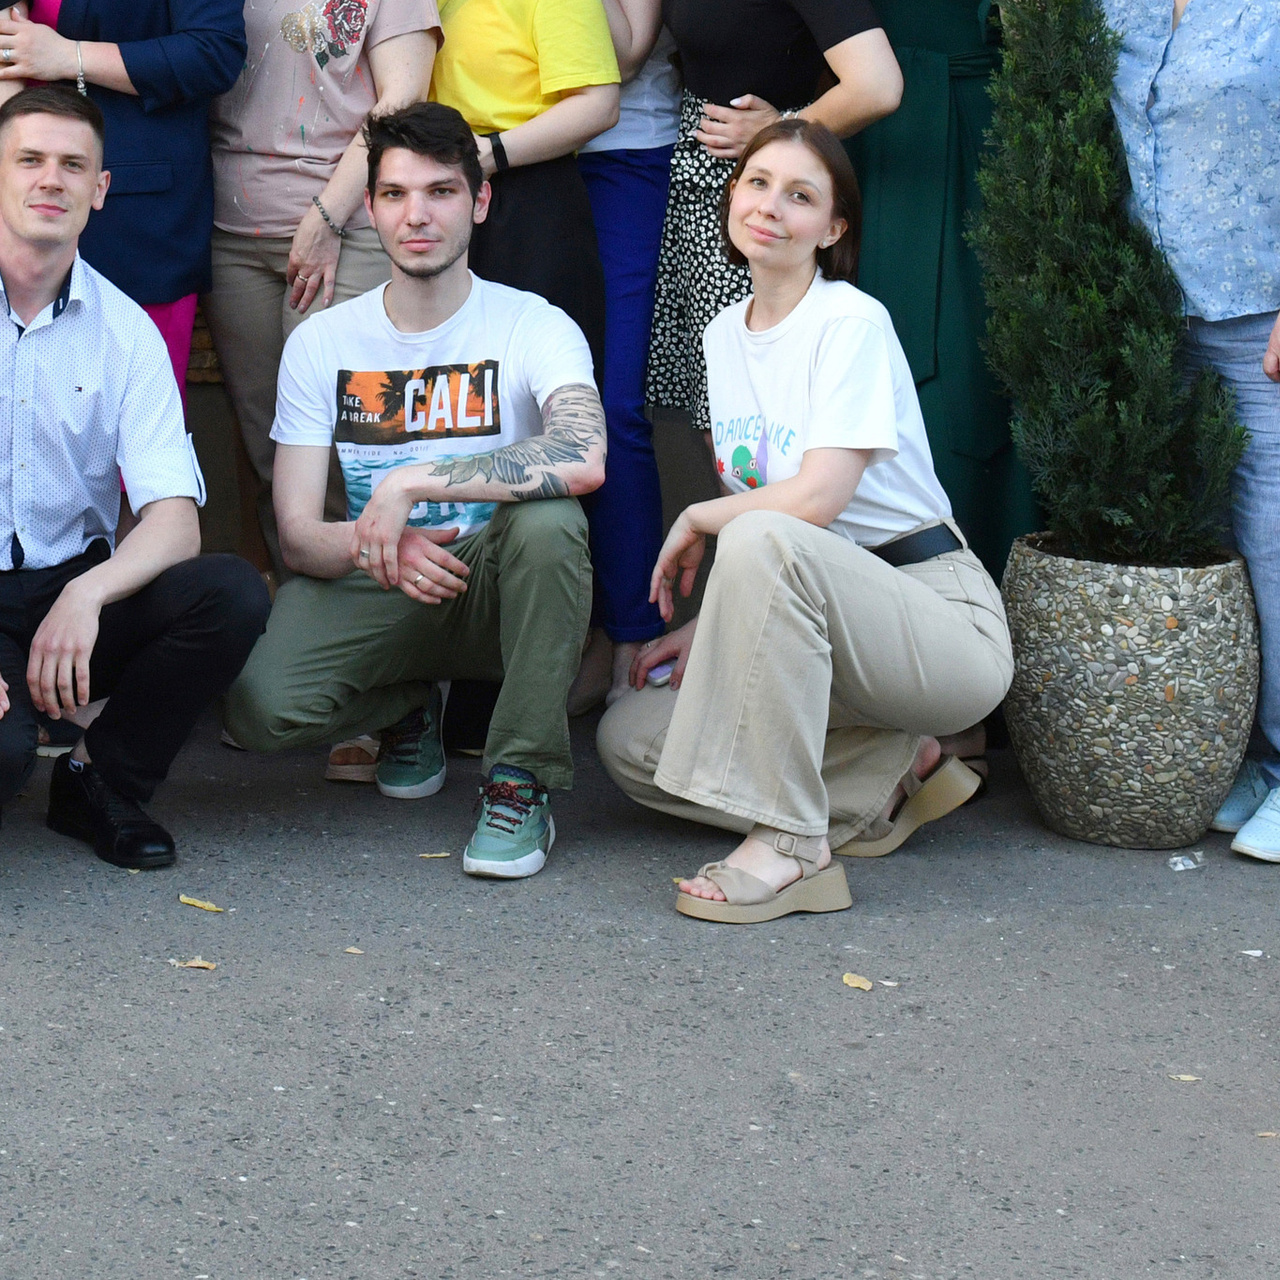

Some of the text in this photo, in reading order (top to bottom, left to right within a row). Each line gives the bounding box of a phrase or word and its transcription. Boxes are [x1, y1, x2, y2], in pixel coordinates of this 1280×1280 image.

[341, 410, 348, 421] A
[404, 369, 494, 433] CALI
[715, 414, 762, 446] DANCE
